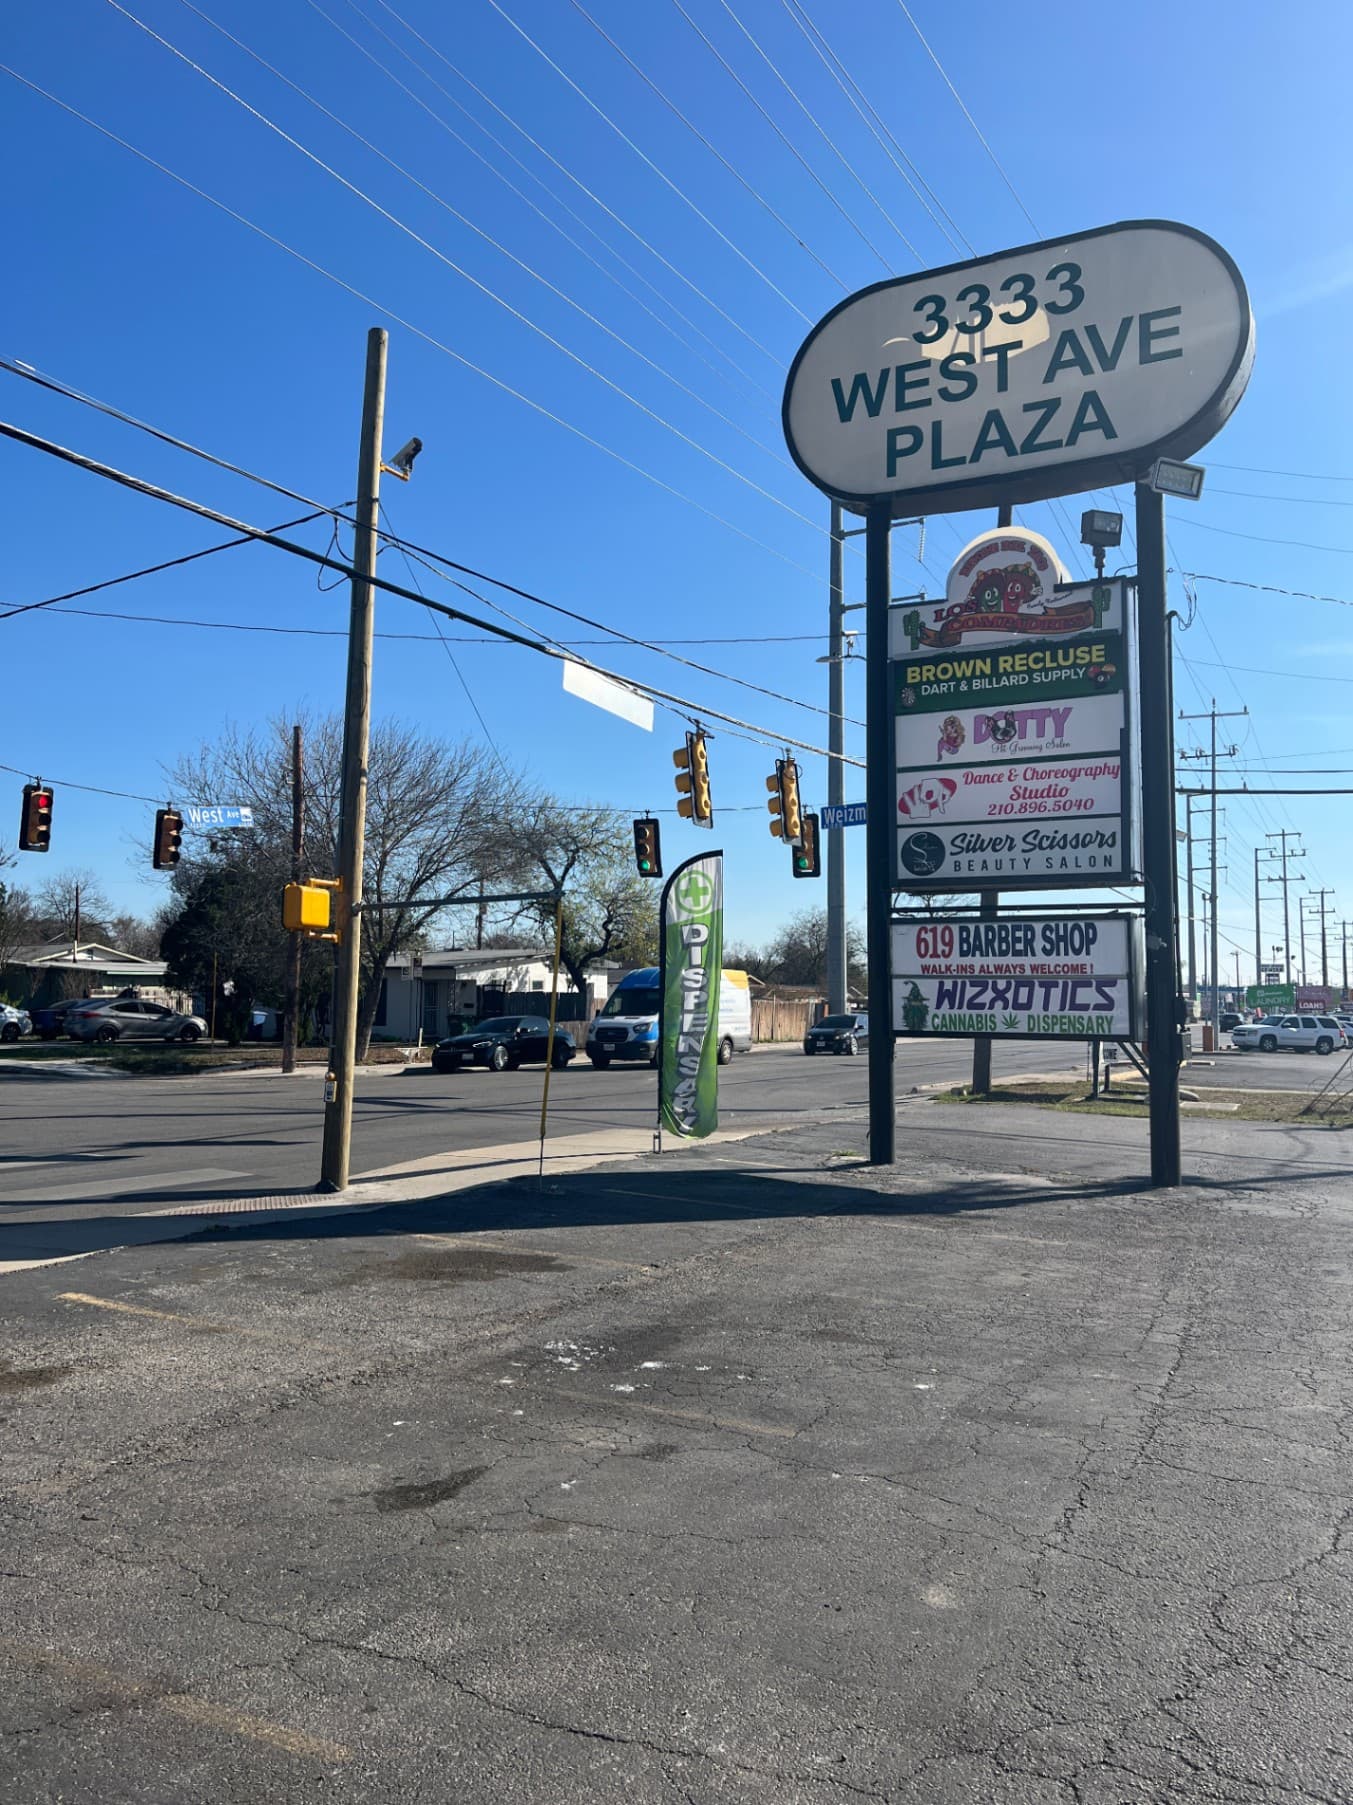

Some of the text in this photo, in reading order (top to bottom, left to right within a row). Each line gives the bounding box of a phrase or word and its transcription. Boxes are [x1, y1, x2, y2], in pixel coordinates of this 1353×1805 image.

[912, 262, 1085, 344] 3333
[831, 305, 1183, 423] WEST AVE
[886, 390, 1119, 478] PLAZA
[907, 645, 1105, 683] BROWN RECLUSE
[921, 667, 1086, 696] DART & BILLARD SUPPLY
[974, 707, 1072, 745] DOTTY
[963, 762, 1120, 785] Dance & Choreography
[1009, 784, 1071, 801] Studio
[188, 807, 240, 823] West Ave
[824, 806, 866, 825] Weizm
[987, 798, 1095, 816] 210.896.5040
[950, 829, 1117, 856] Silver Scissors
[953, 855, 1112, 872] BEAUTY SALON
[916, 922, 1098, 959] 619 BARBER SHOP
[921, 964, 975, 974] WALK-INS
[979, 964, 1025, 974] ALWAYS
[935, 980, 1118, 1012] WIZXOTICS
[931, 1013, 1114, 1033] CANNABIS DISPENSARY
